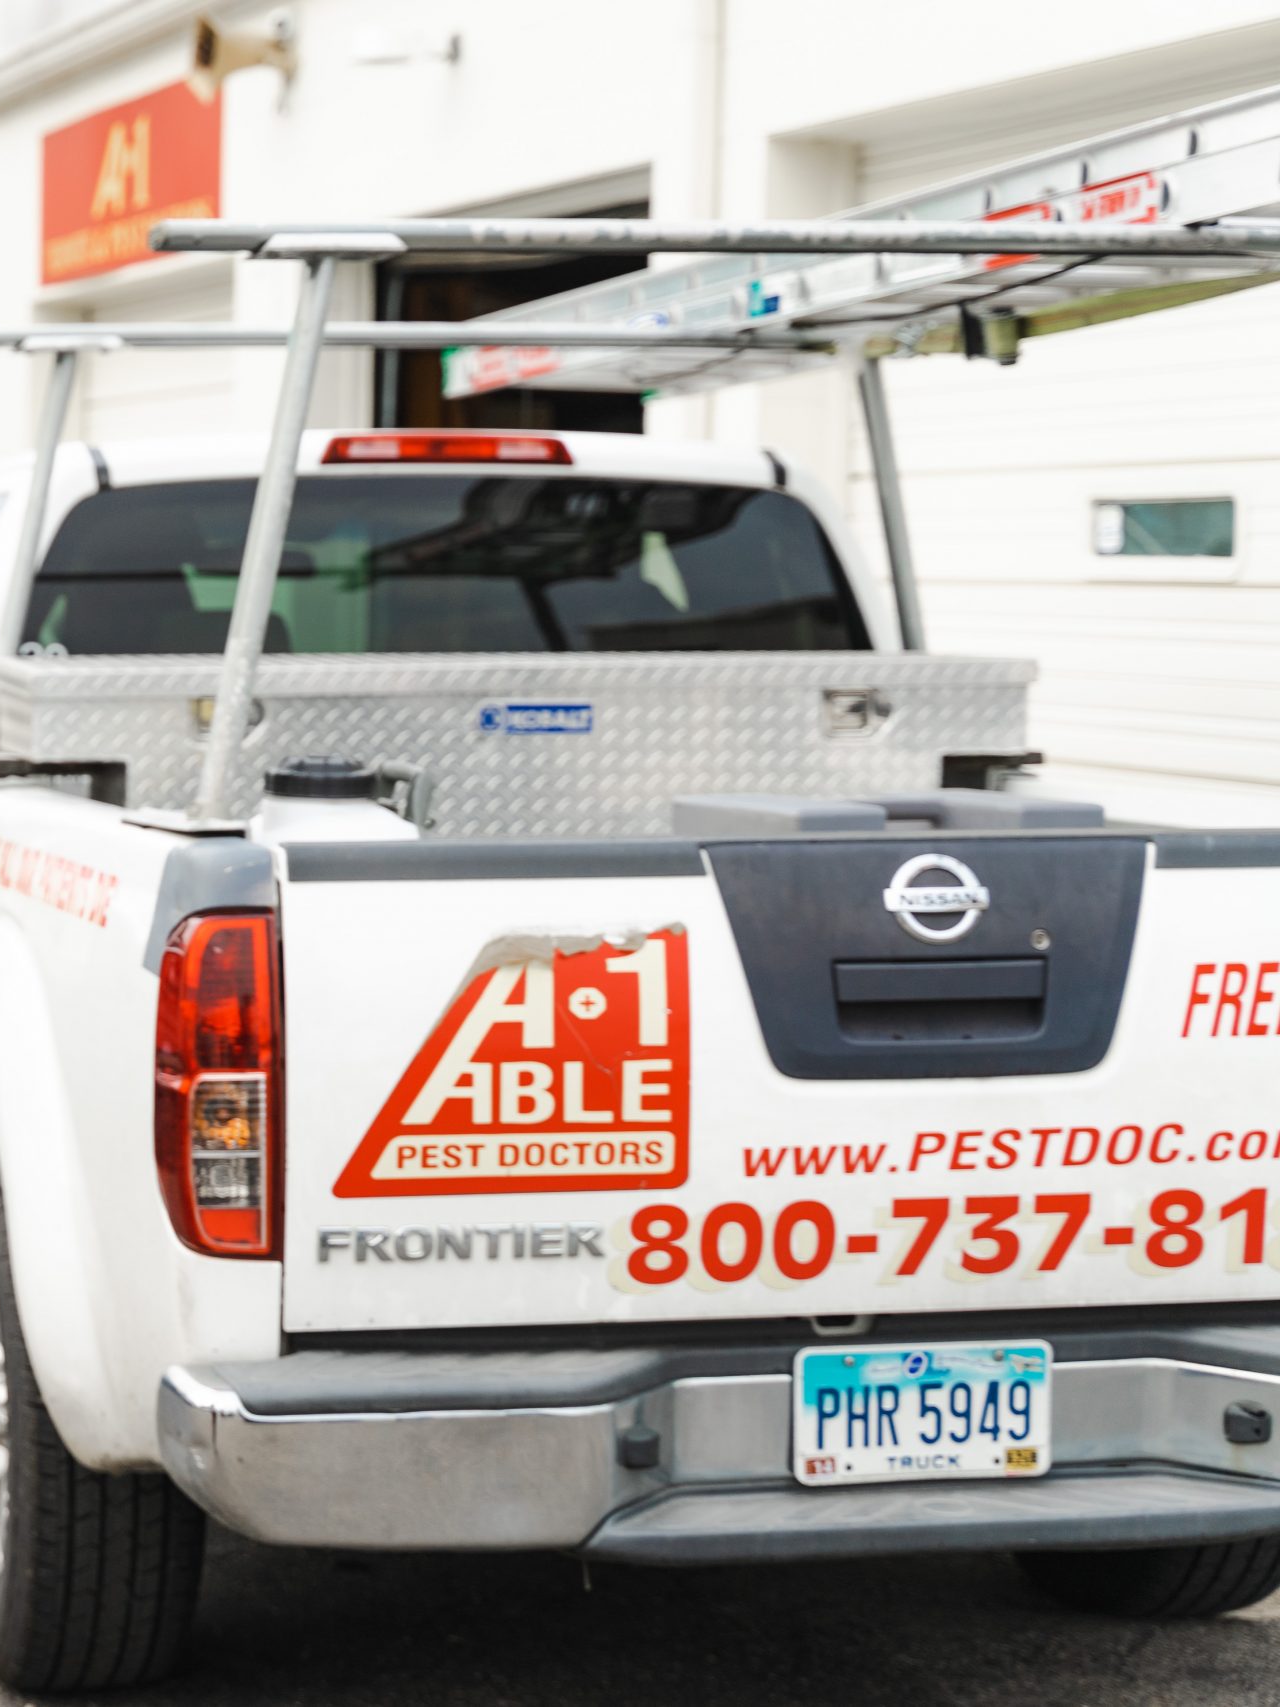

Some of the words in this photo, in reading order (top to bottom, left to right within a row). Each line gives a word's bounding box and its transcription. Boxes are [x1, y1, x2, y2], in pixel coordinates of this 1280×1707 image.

[900, 892, 977, 906] NISSAN
[1181, 962, 1280, 1037] FRE
[400, 1058, 673, 1126] ABLE
[396, 1143, 486, 1169] PEST
[498, 1140, 664, 1168] DOCTORS
[743, 1123, 1280, 1178] www.PESTDOC.co
[316, 1220, 606, 1264] FRONTIER
[627, 1188, 1267, 1285] 800-737-81
[816, 1384, 900, 1450] PHR
[918, 1379, 1032, 1445] 5949
[886, 1454, 961, 1470] TRUCK
